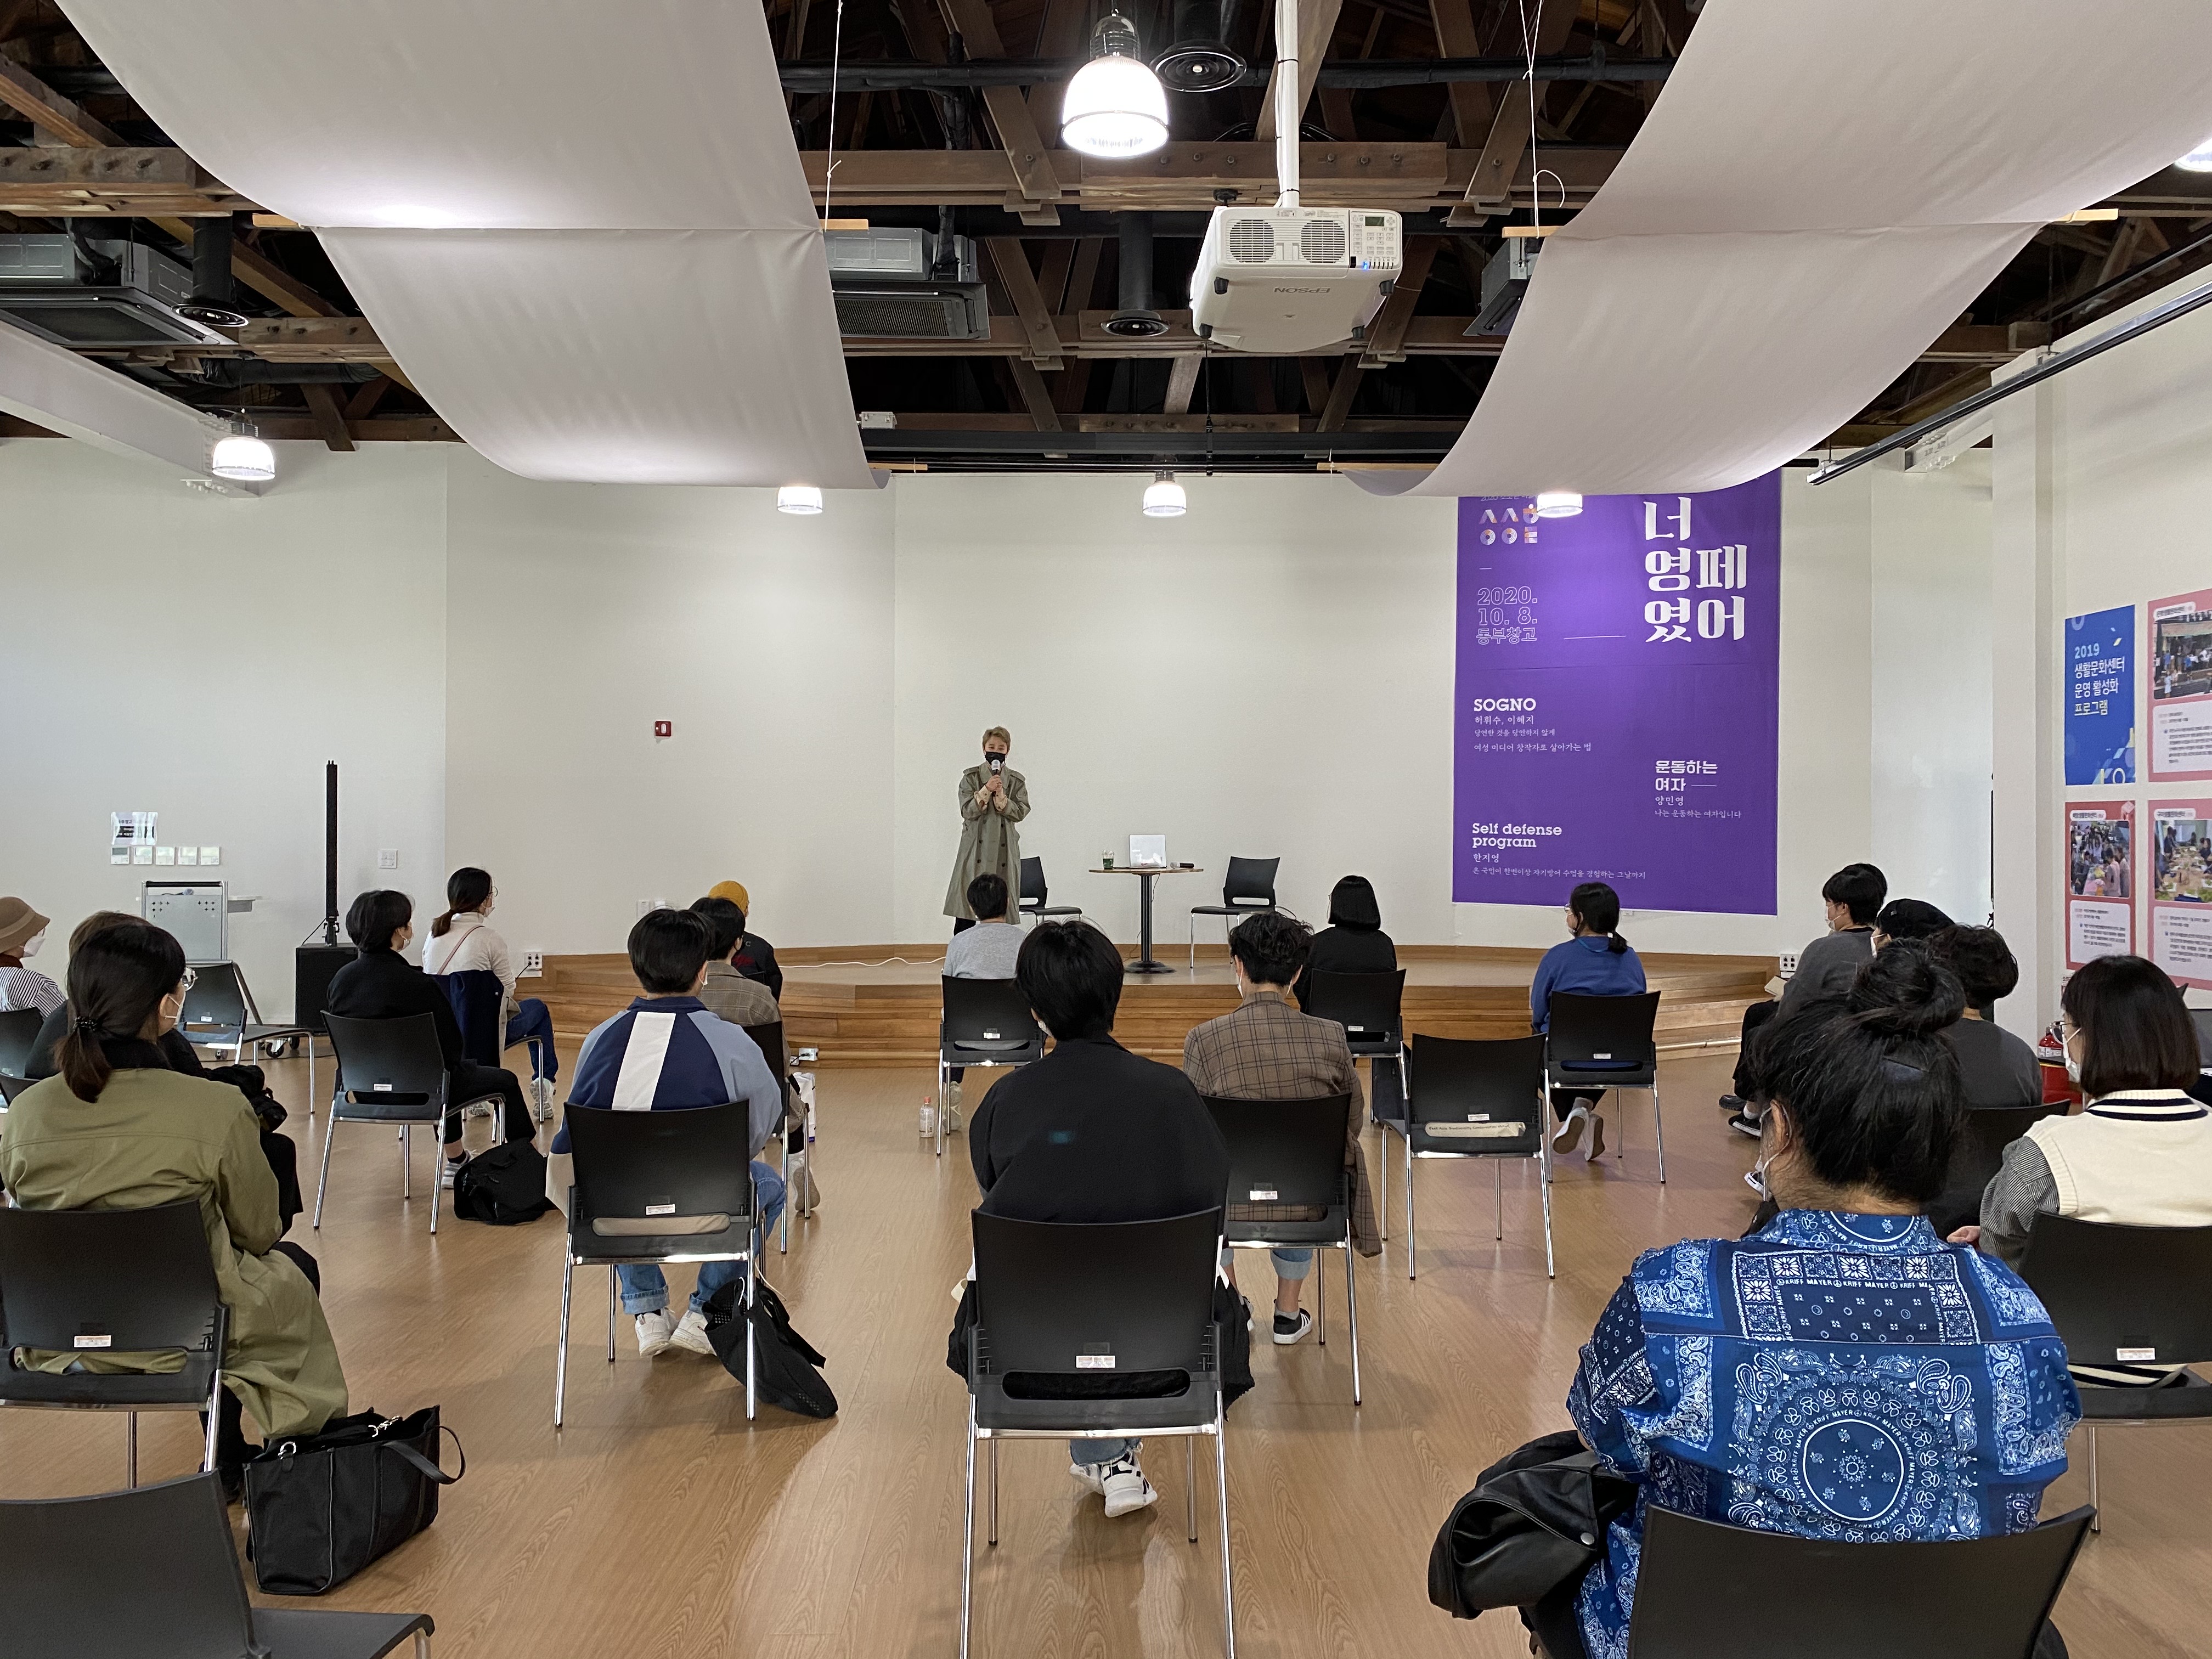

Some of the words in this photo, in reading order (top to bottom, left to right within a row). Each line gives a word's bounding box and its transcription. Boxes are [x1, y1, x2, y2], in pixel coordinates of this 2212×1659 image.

[1643, 496, 1691, 541] 너
[1477, 586, 1537, 606] 2020.
[1478, 607, 1510, 625] 10.
[1517, 606, 1537, 624] 8.
[1645, 596, 1745, 642] 였어
[1476, 627, 1537, 645] 동부창고
[2074, 642, 2100, 659] 2019
[2074, 656, 2125, 679] 생활문화센터
[2074, 681, 2091, 698] 운영
[2093, 678, 2119, 697] 활성화
[1474, 698, 1537, 712] SOGNO
[2074, 699, 2108, 716] 프로그램
[1512, 729, 1539, 737] 당연하지
[1474, 743, 1489, 752] 여성
[1491, 743, 1514, 752] 미디어
[1516, 743, 1548, 752] 창작자로
[1550, 743, 1581, 752] 살아가는
[1584, 742, 1592, 752] 법
[1655, 760, 1718, 774] 운동하는
[1655, 777, 1686, 792] 여자
[1655, 795, 1684, 806] 양민영
[1654, 809, 1669, 817] 나는
[1672, 810, 1701, 818] 운동하는
[1703, 810, 1741, 819] 여자입니다
[1472, 823, 1499, 834] Self
[1502, 823, 1562, 836] defense
[1472, 837, 1537, 850] program
[1473, 853, 1499, 863] 한지영
[1481, 867, 1502, 875] 국민이
[1533, 868, 1561, 877] 자기방어
[1563, 870, 1584, 878] 수업을
[1586, 870, 1615, 878] 경험하는
[1617, 871, 1646, 879] 그날까지
[1831, 1409, 1853, 1418] MAYER
